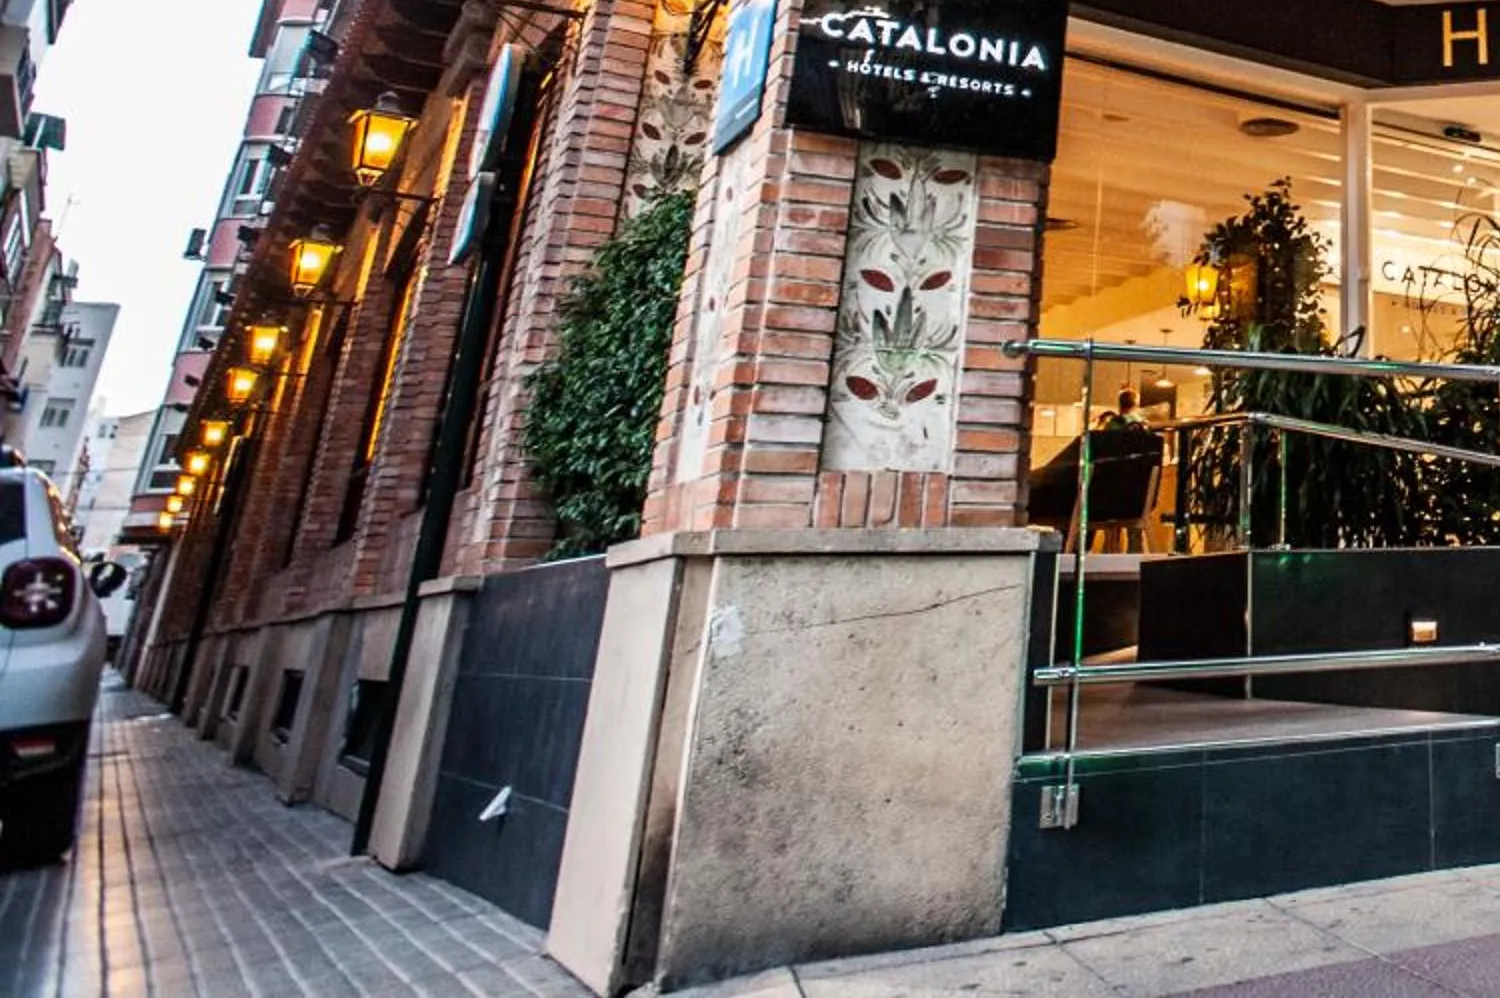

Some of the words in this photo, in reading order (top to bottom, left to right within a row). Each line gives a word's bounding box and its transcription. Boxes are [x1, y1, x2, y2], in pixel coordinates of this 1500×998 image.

[820, 11, 1047, 72] CATALONIA
[847, 60, 917, 82] HOTELS
[937, 72, 1015, 97] RESORTS
